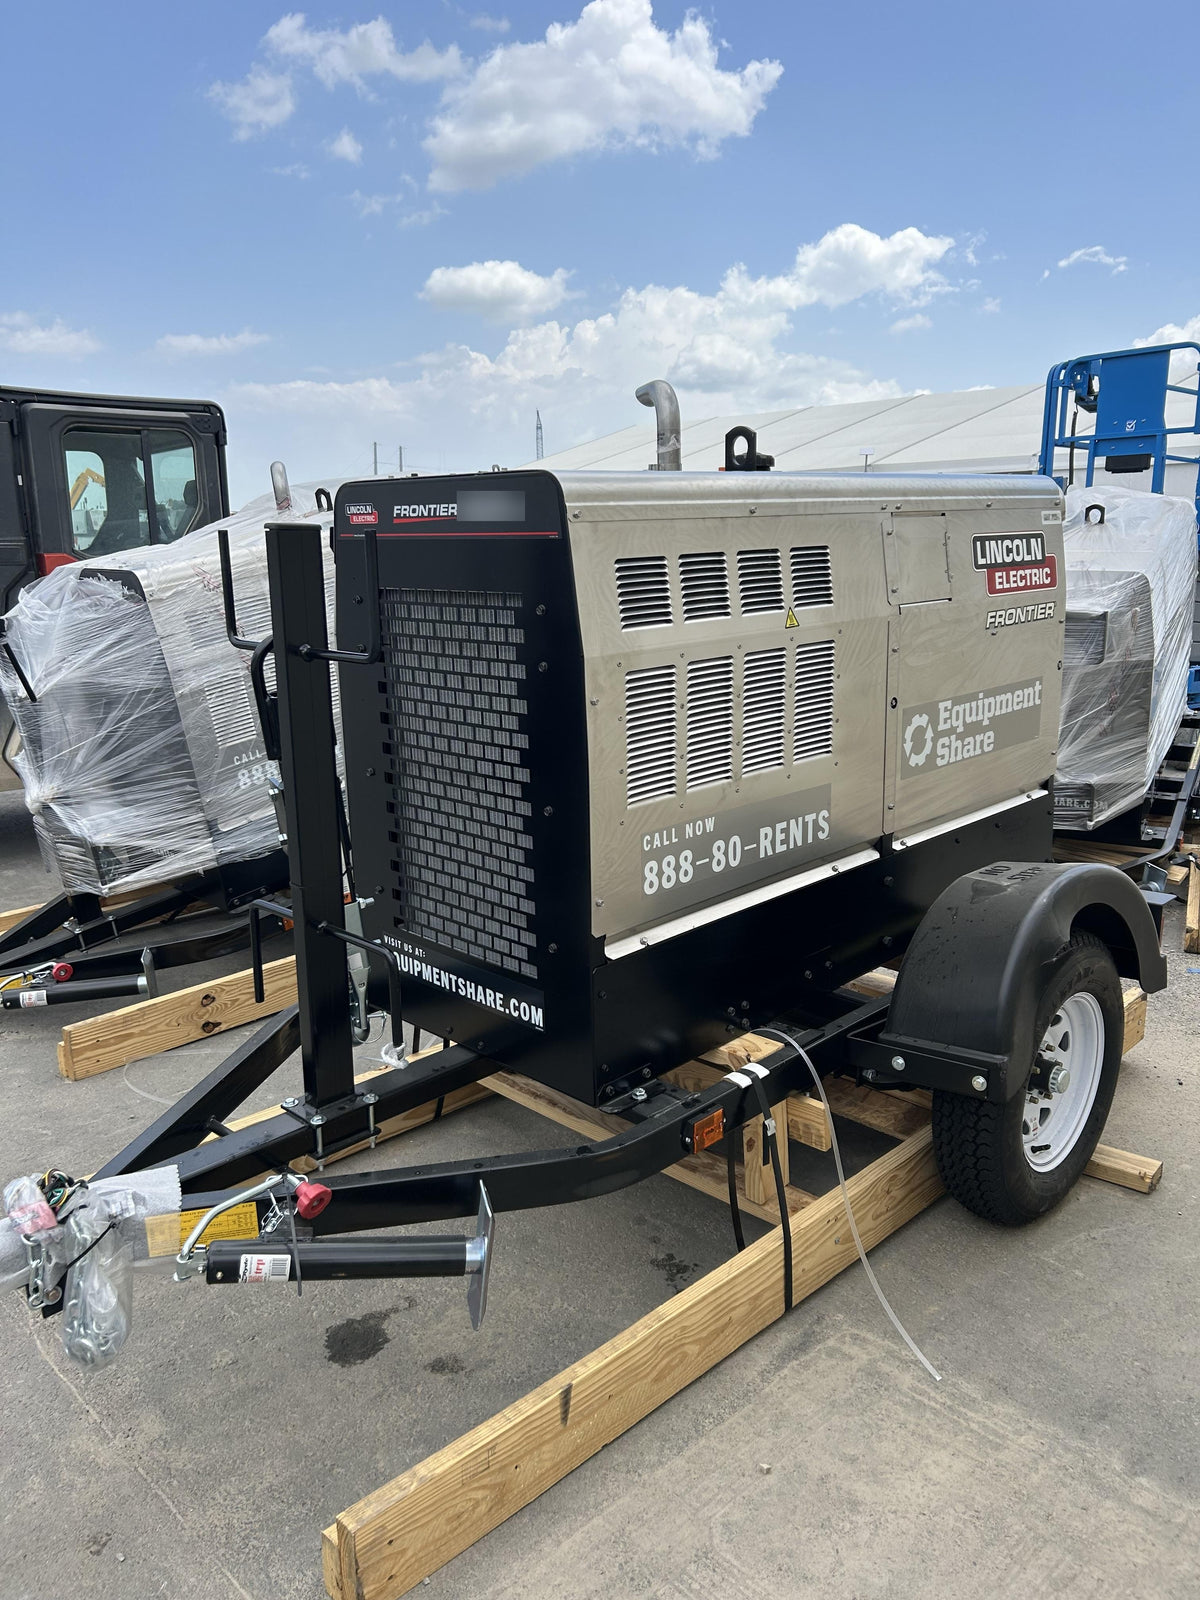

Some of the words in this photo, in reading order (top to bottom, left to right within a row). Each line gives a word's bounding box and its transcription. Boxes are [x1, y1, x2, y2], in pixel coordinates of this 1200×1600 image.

[346, 505, 372, 514] LINCOLN
[393, 503, 457, 517] FRONTIER
[976, 538, 1043, 565] LINCOLN
[994, 567, 1051, 590] ELECTRIC
[985, 601, 1055, 629] FRONTIER
[937, 680, 1042, 733] Equipment
[233, 750, 263, 765] CALL
[936, 730, 995, 767] Share
[643, 828, 678, 851] CALL
[685, 816, 716, 839] NOW
[643, 809, 830, 895] 888-80-RENTS
[979, 865, 1012, 876] NO
[383, 934, 402, 949] VISIT
[403, 943, 413, 954] US
[415, 947, 426, 958] AT:
